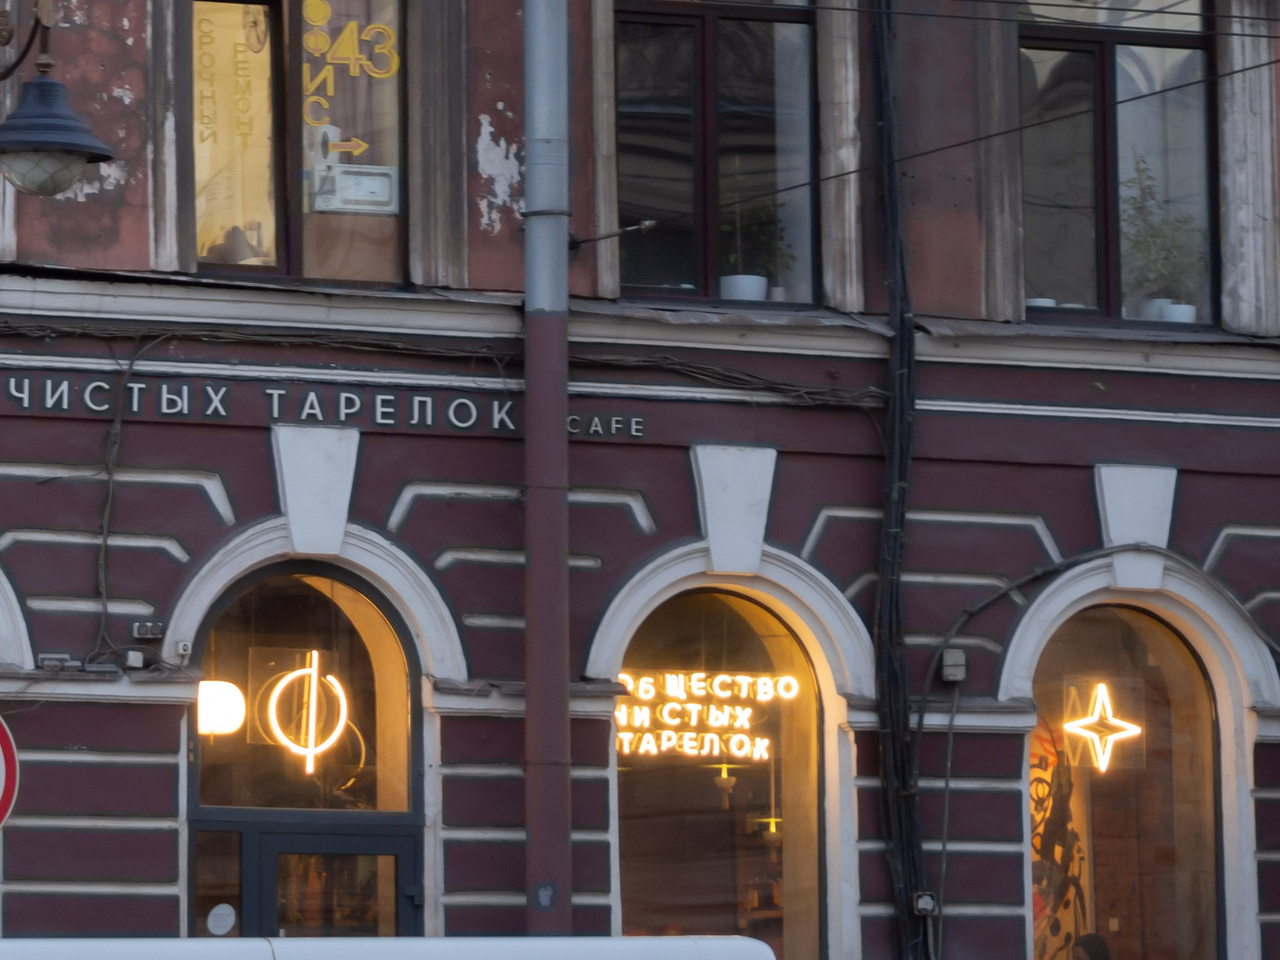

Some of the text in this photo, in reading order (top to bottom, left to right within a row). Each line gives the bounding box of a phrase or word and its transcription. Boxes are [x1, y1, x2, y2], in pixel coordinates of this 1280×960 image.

[326, 20, 400, 79] 43
[233, 42, 254, 149] РЕМОНТ
[9, 377, 228, 416] ЧИСТЫХ
[265, 388, 516, 430] ТАРЕЛОК
[566, 415, 644, 436] CAFE
[617, 730, 769, 760] ТАРЕЛОК
